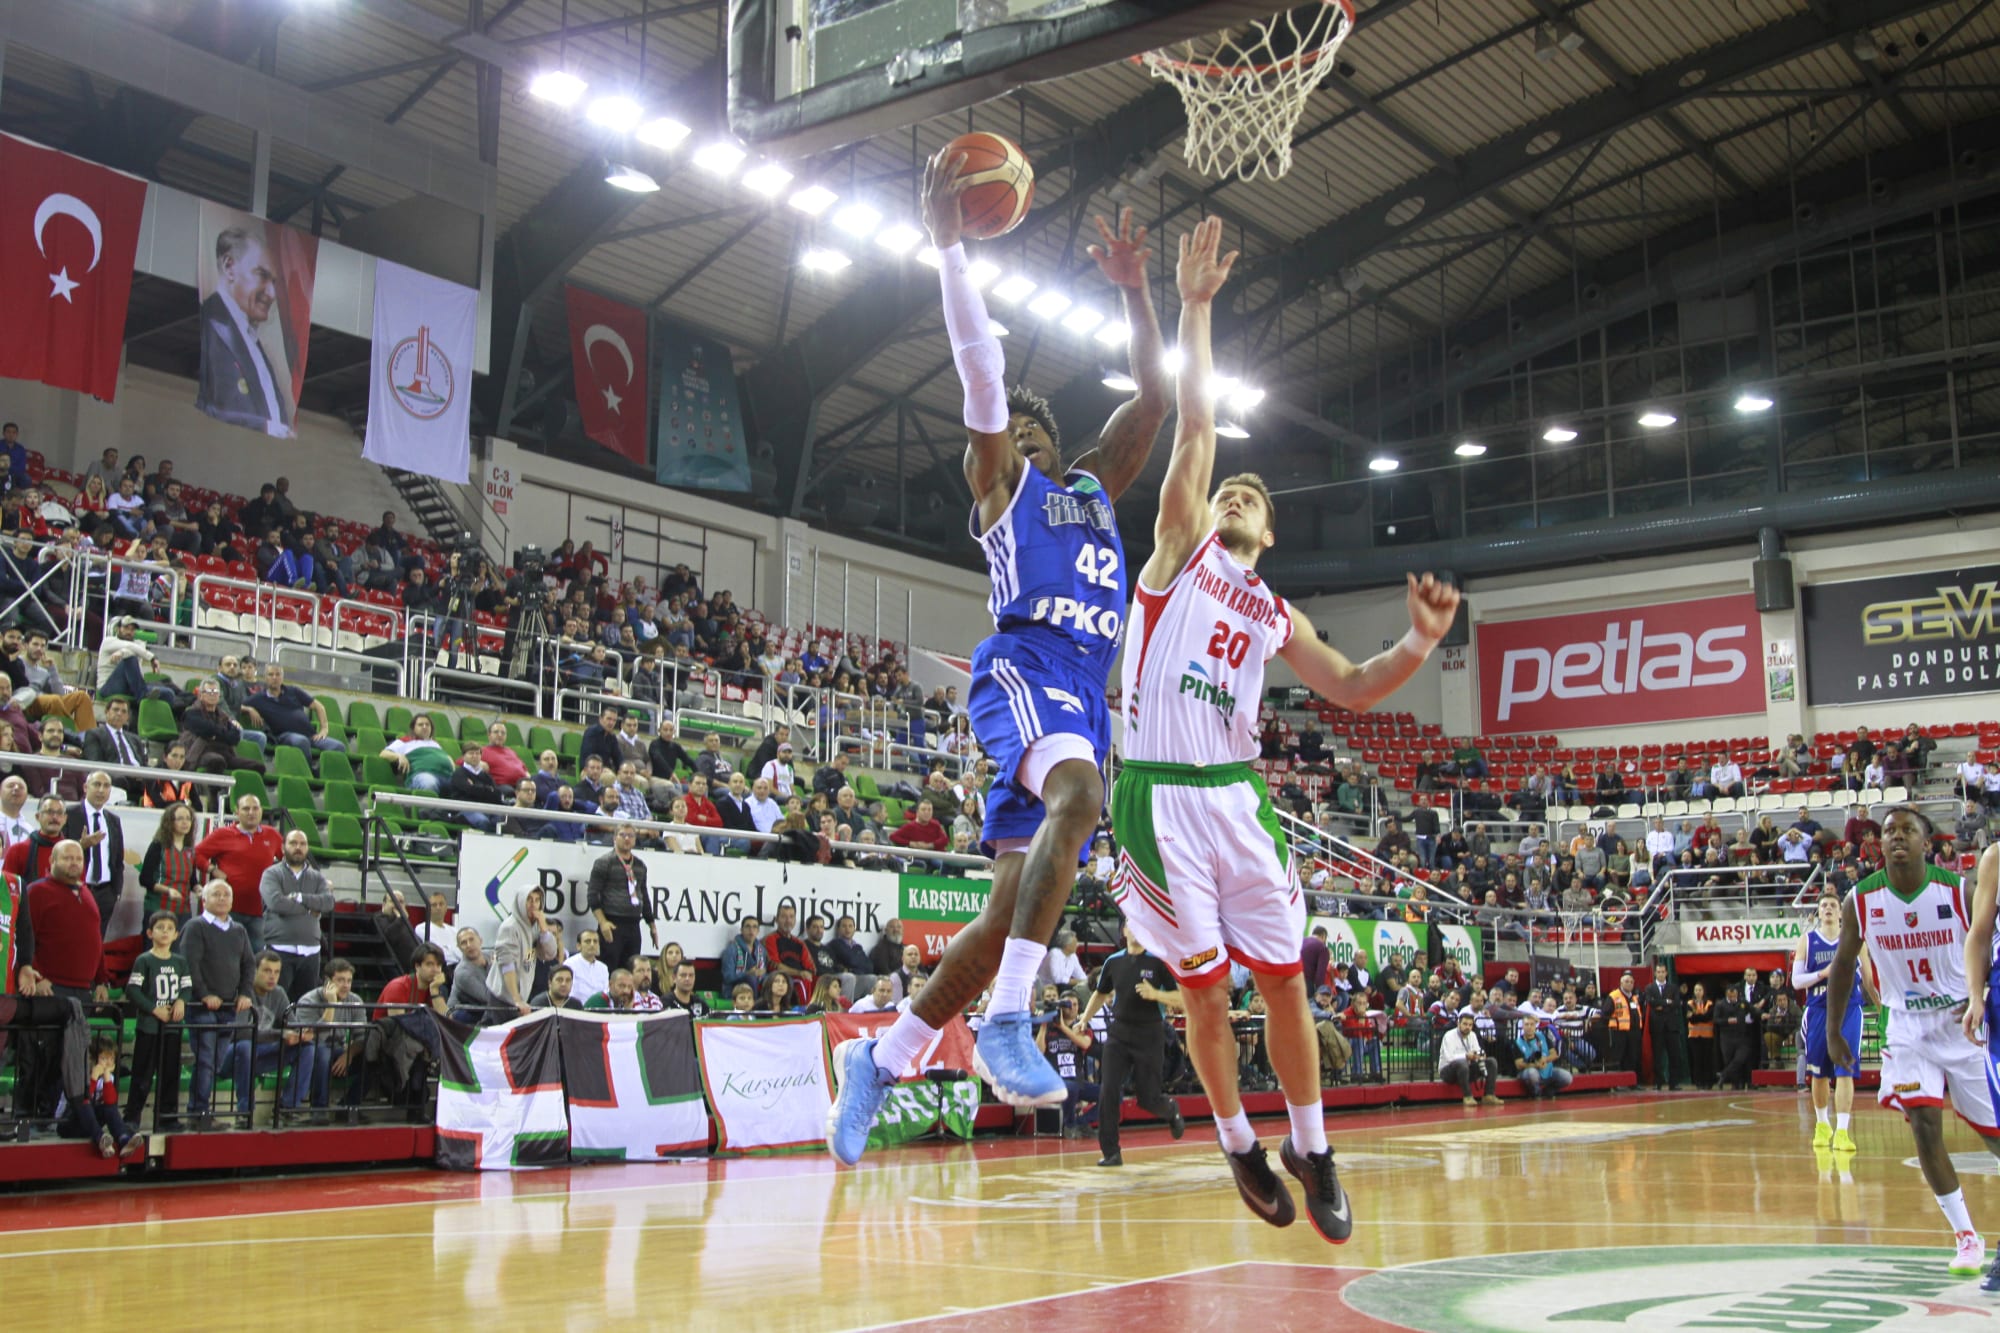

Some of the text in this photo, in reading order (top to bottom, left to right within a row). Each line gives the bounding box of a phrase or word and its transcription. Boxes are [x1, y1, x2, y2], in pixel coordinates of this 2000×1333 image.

[492, 467, 510, 483] C-3
[486, 482, 514, 500] BLOK
[1075, 543, 1119, 590] 42
[1193, 563, 1230, 604] PINAR
[1207, 620, 1251, 670] 20
[1446, 648, 1461, 659] D-1
[1441, 660, 1466, 671] BLOK
[1497, 619, 1747, 721] petlas
[1857, 671, 1930, 691] PASTA
[536, 866, 743, 926] BURANG
[1696, 923, 1801, 944] KARŞIYAKA
[1876, 934, 1903, 951] PINAR
[1327, 941, 1354, 966] NAR
[1907, 958, 1934, 984] 14
[156, 974, 179, 1000] 02
